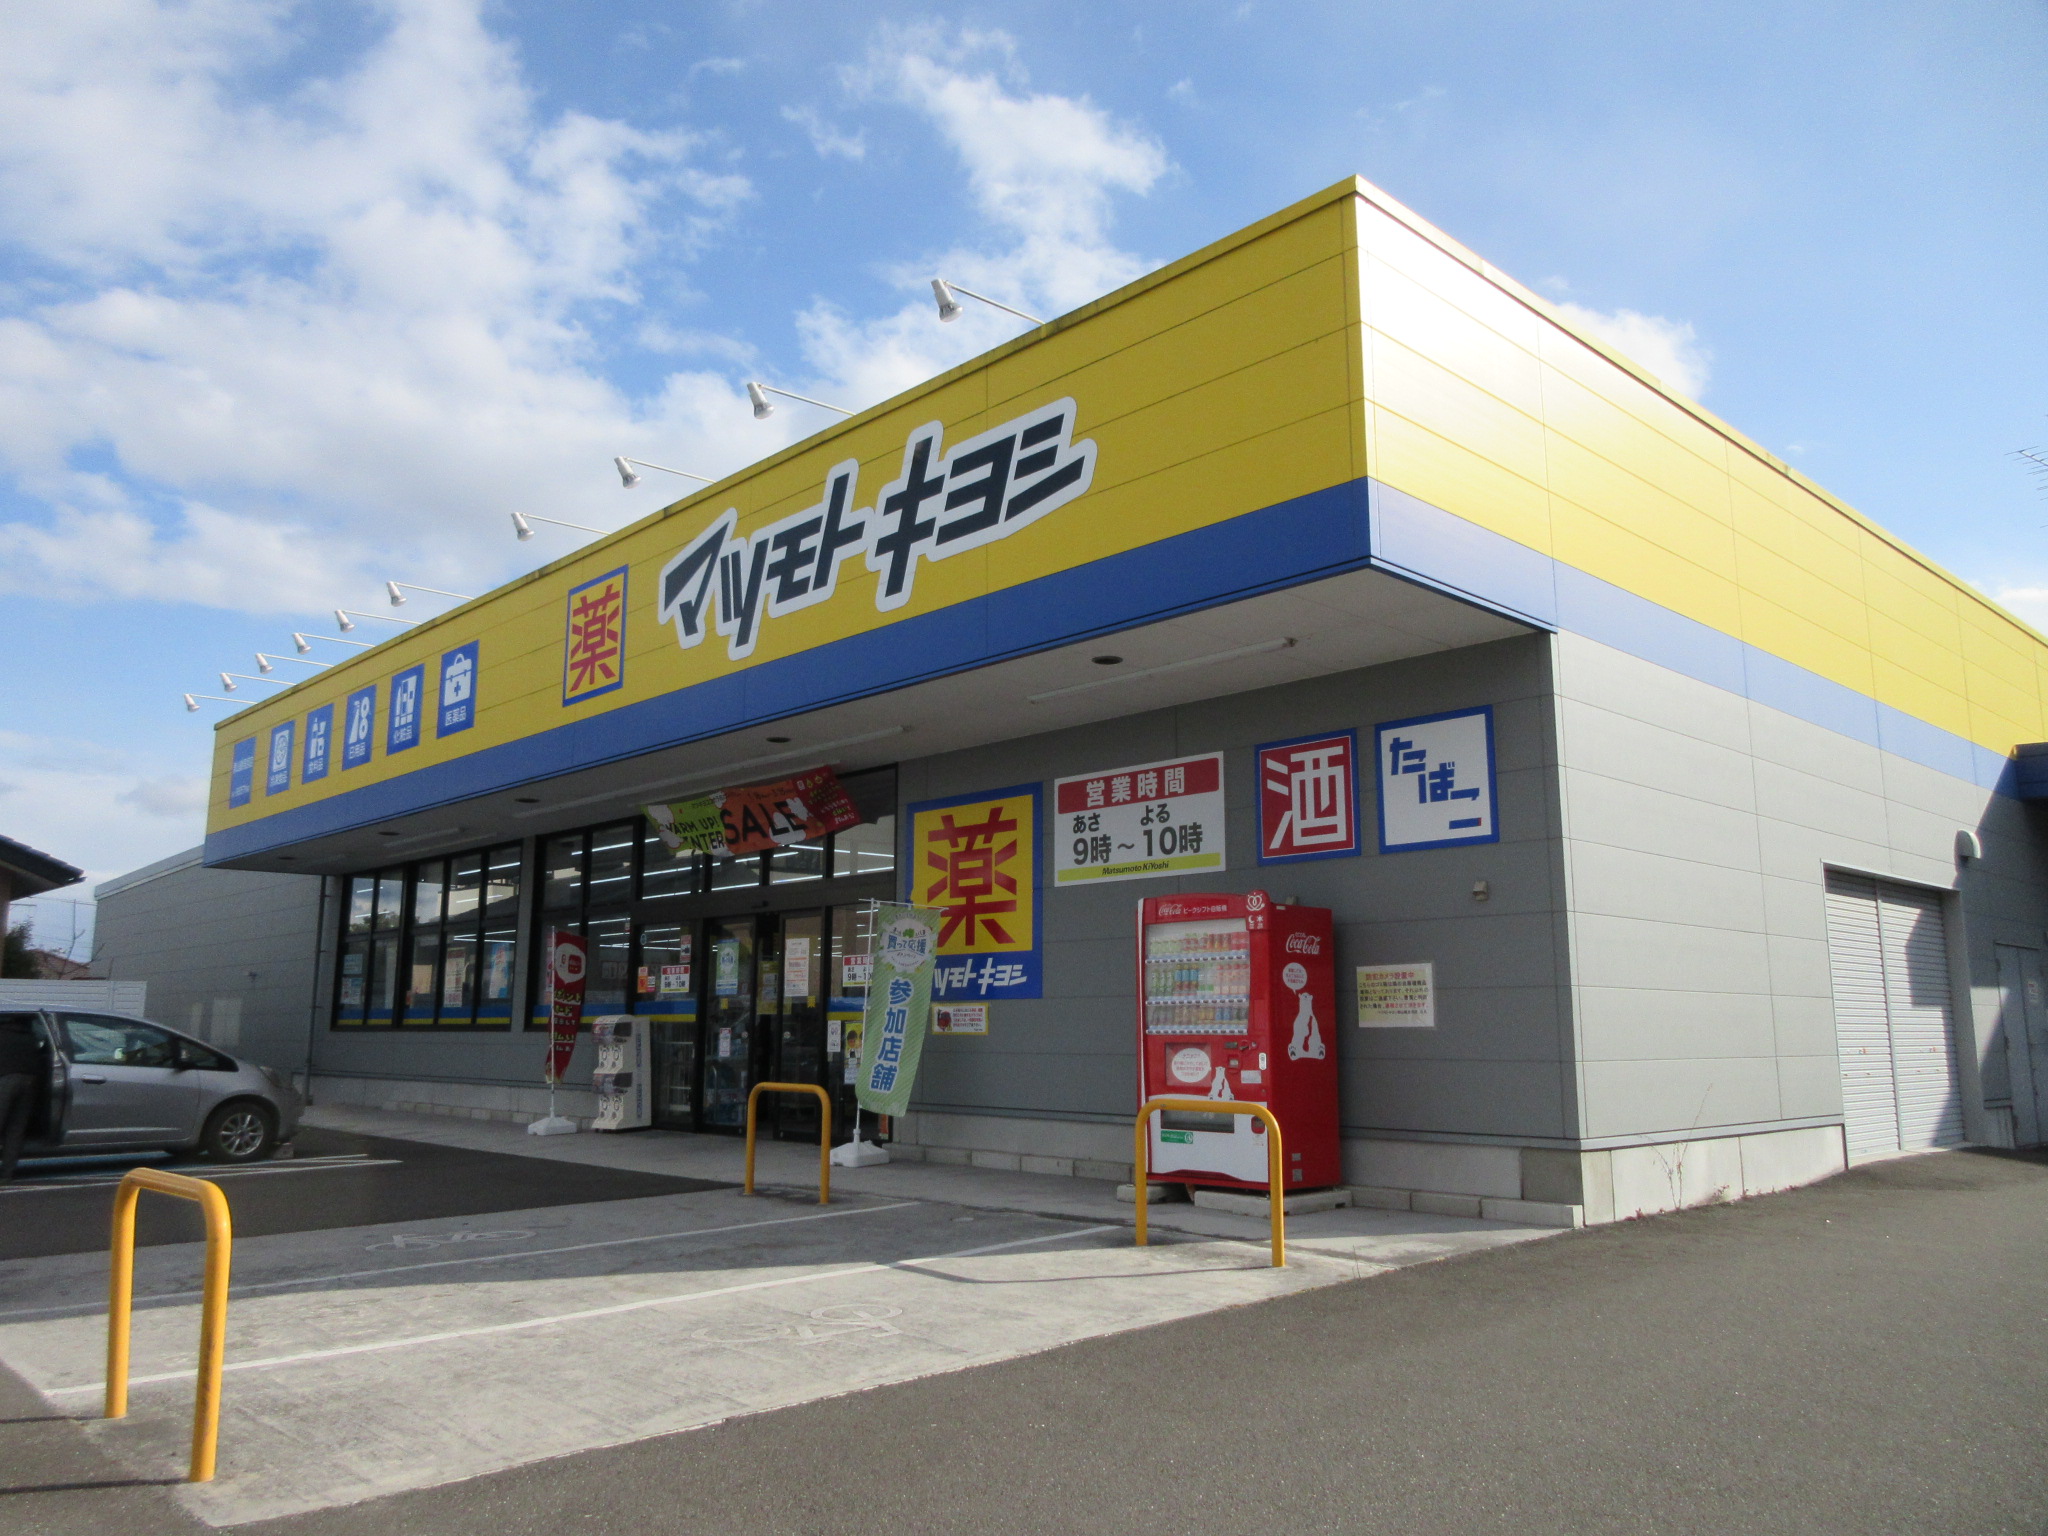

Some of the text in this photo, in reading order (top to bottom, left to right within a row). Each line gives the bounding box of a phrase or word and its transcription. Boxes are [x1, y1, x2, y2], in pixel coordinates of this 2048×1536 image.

[663, 412, 1087, 650] マツモトキヨシ
[569, 582, 623, 693] 薬
[1086, 766, 1186, 809] 営業時間
[1265, 745, 1348, 850] 酒
[1389, 736, 1482, 830] たばこ
[699, 816, 721, 831] UP!
[719, 799, 809, 846] SALE
[1072, 802, 1171, 835] あさ よる
[927, 806, 1018, 949] 薬
[1102, 861, 1143, 876] Matsumoto
[886, 934, 928, 955] 買って応援
[1285, 933, 1322, 955] Coca-Cola
[933, 956, 1029, 997] ツモトキヨシ
[870, 978, 913, 1092] 参加店舗
